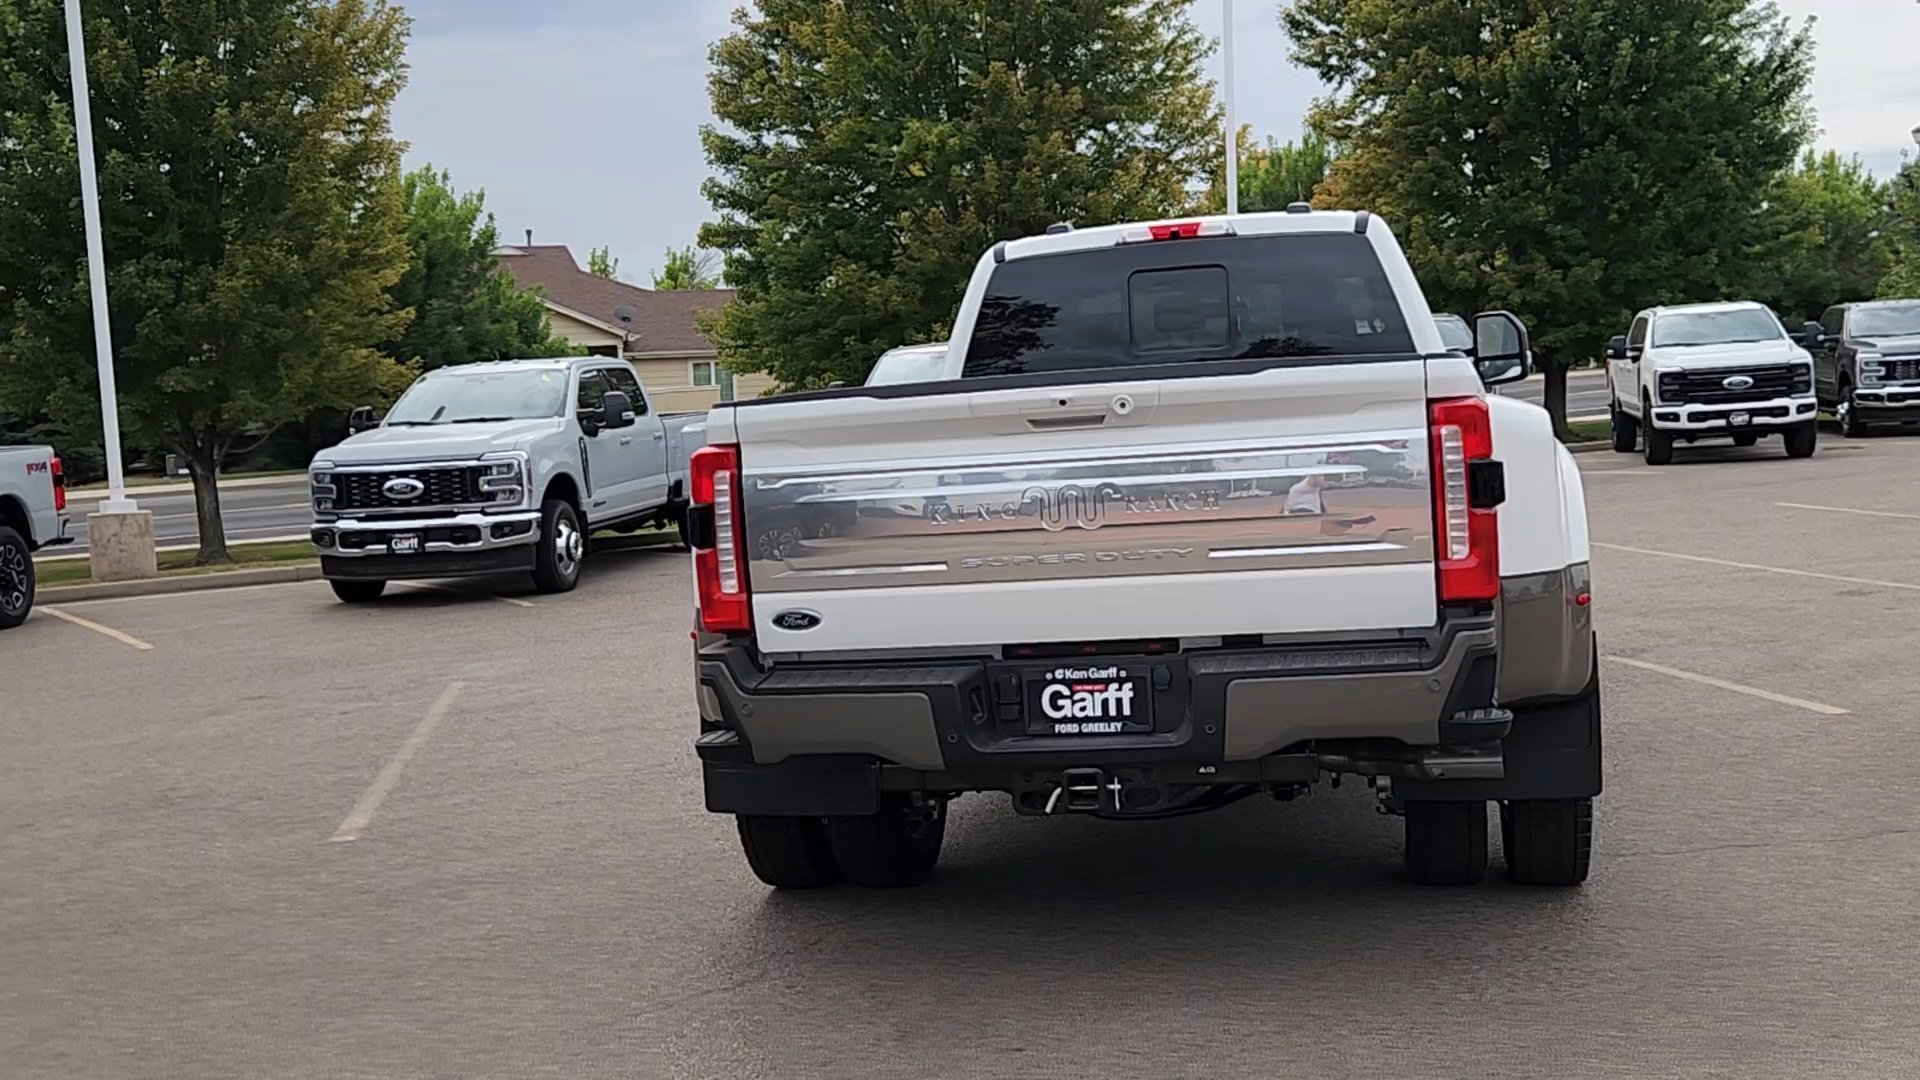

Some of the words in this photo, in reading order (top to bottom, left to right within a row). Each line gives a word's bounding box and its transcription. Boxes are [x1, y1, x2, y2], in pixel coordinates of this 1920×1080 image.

[929, 503, 1017, 525] KING
[1124, 488, 1220, 514] RANCH
[961, 552, 1087, 569] SUPER
[1096, 547, 1195, 563] DUTY
[782, 613, 810, 626] Ford
[1064, 668, 1088, 680] Ken
[1088, 666, 1118, 679] Garff
[1041, 682, 1134, 719] Garff
[1054, 723, 1080, 734] FORD
[1081, 721, 1123, 733] GREELEY
